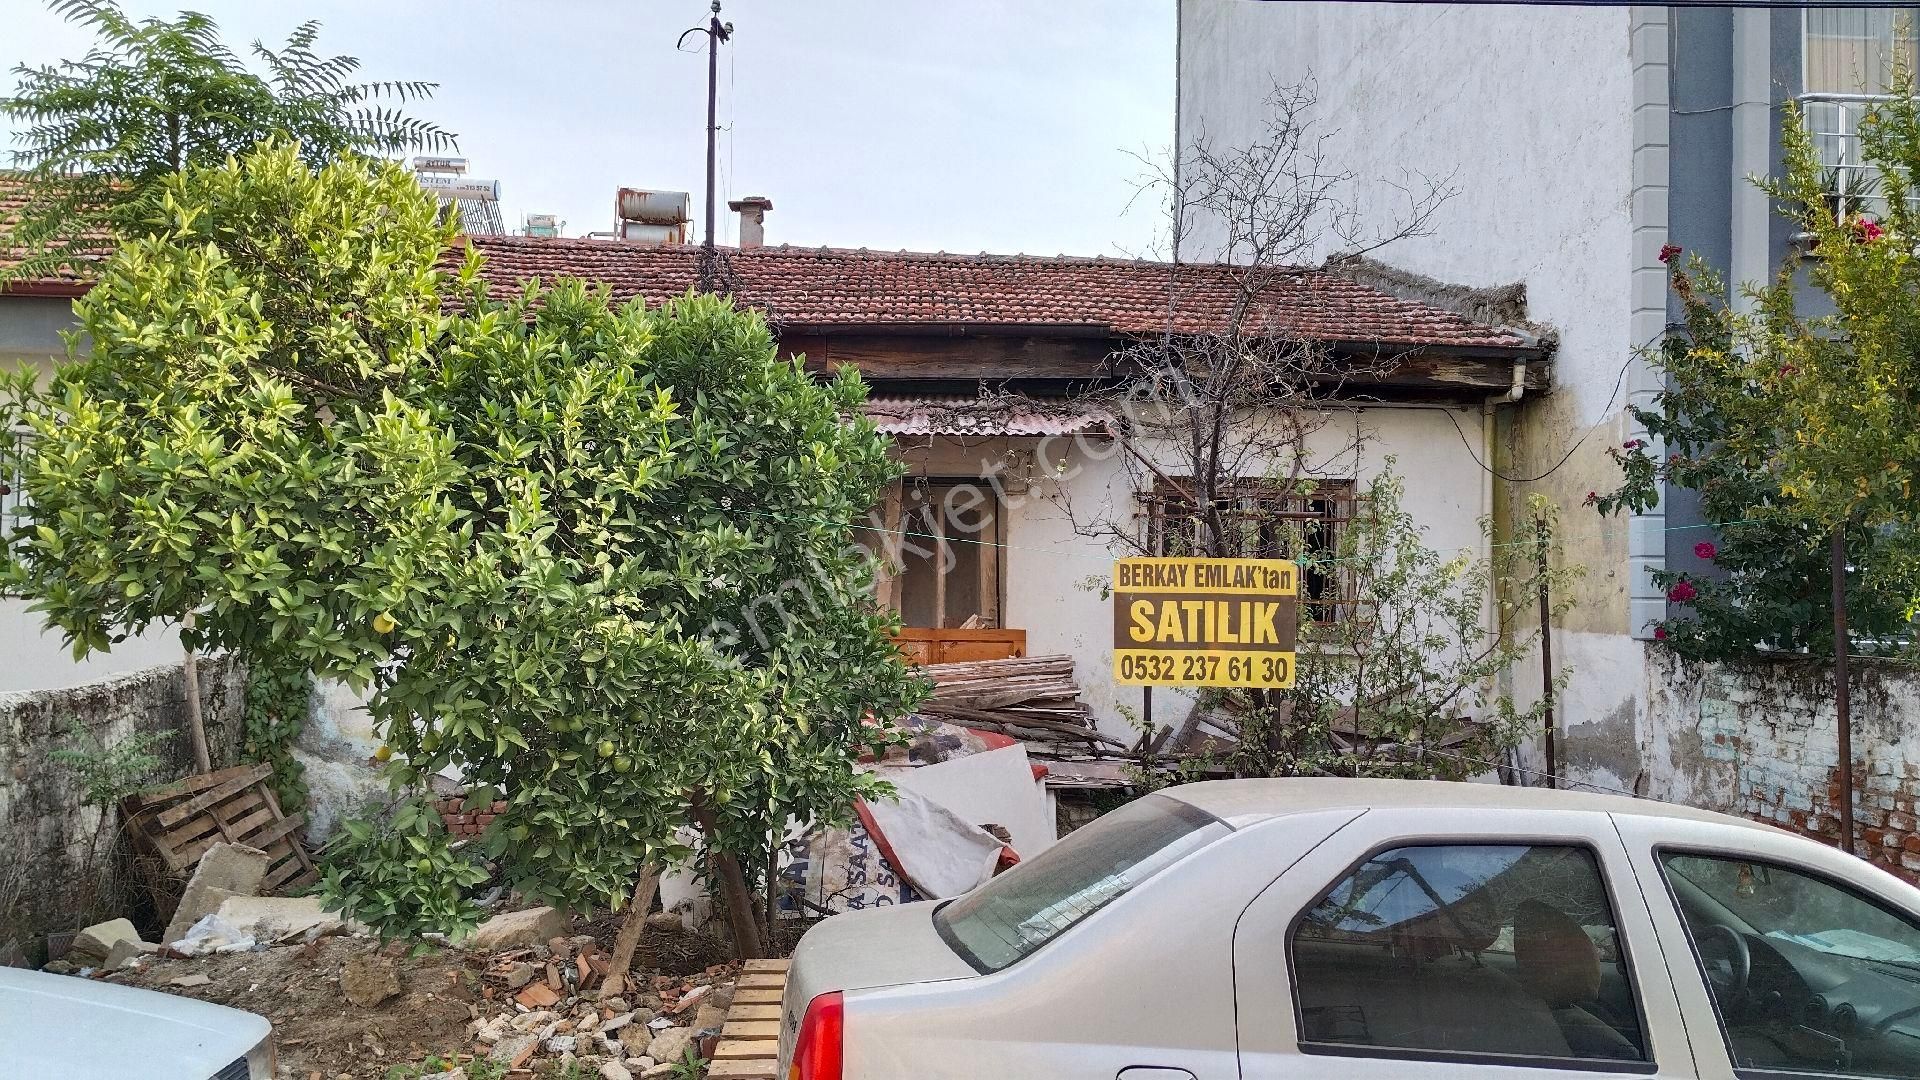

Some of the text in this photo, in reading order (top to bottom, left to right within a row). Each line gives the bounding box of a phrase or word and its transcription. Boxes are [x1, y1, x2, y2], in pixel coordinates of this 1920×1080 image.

[1119, 563, 1291, 590] BERKAY EMLAK'tan
[1129, 599, 1280, 645] SATILIK
[1120, 654, 1288, 683] 0532 237 61 30
